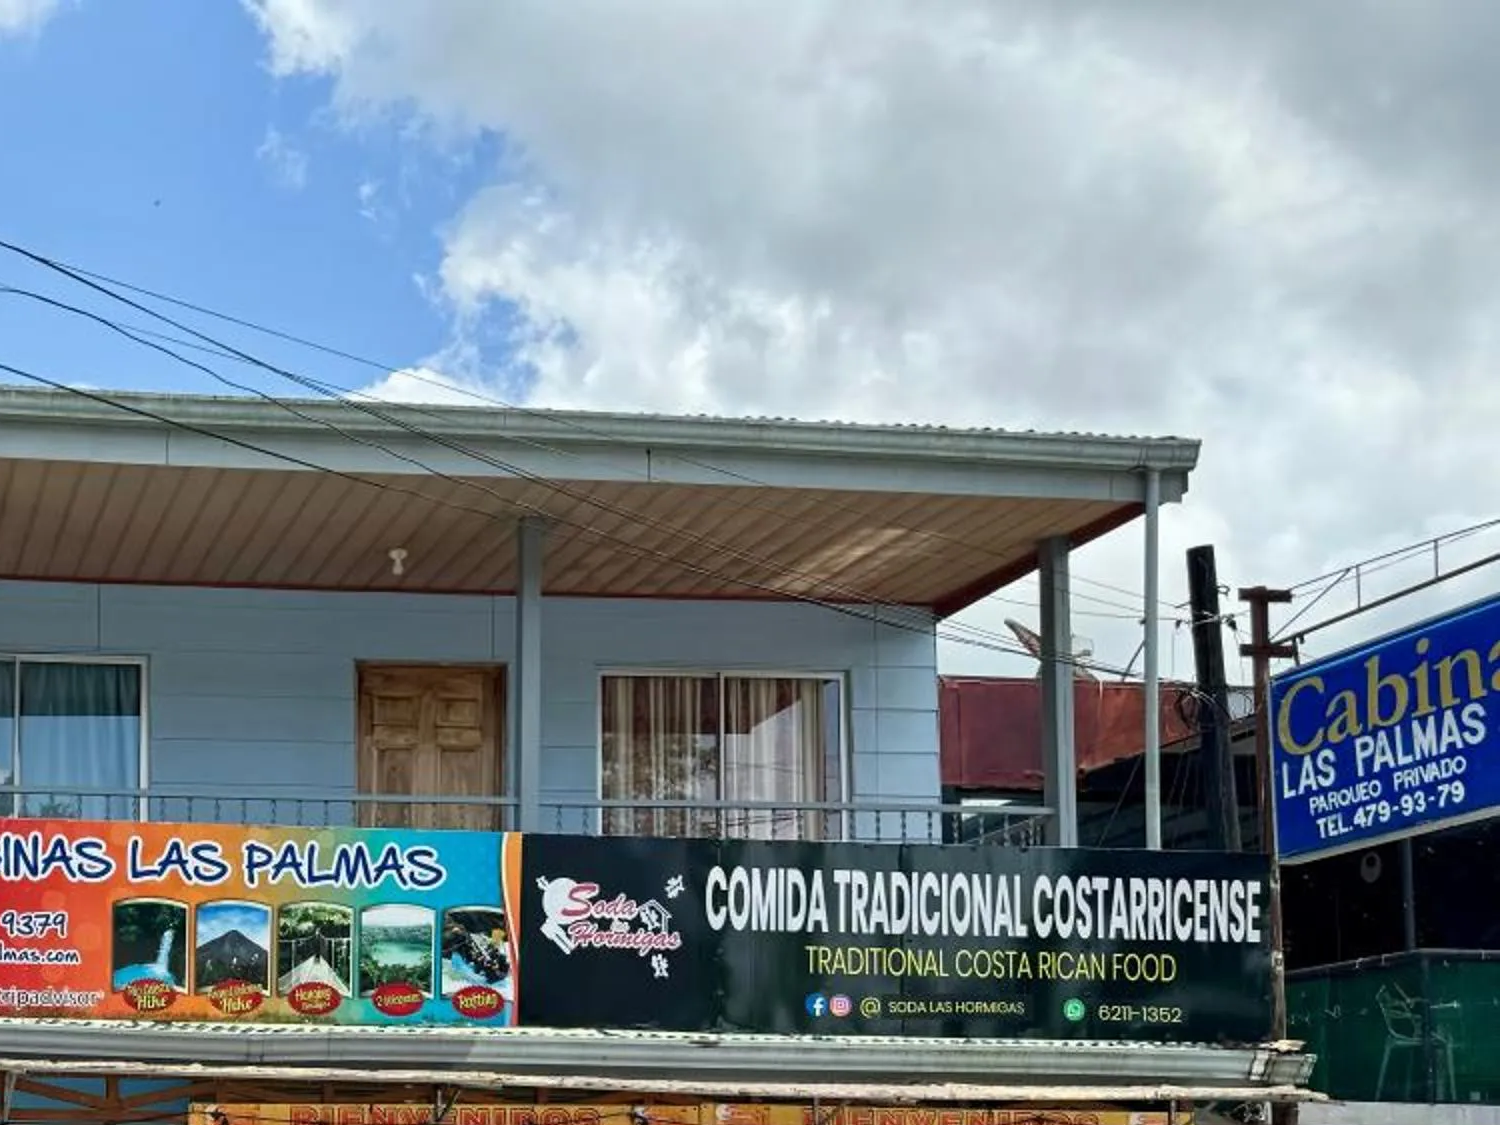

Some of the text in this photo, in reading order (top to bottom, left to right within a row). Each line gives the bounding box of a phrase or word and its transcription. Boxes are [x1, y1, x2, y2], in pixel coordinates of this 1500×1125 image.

[1281, 702, 1487, 799] LAS PALMAS
[1308, 755, 1467, 816] PARQUEO PRIVADO
[128, 835, 229, 883] LAS
[244, 839, 445, 891] PALMAS
[560, 882, 638, 919] Soda
[705, 866, 1261, 943] COMIDA TRADICIONAL COSTARRICENSE
[0, 911, 67, 939] 9379
[567, 920, 682, 956] Hormigas
[805, 945, 1176, 982] TRADITIONAL COSTA RICAN FOOD
[889, 1001, 925, 1013] SODA
[929, 1001, 953, 1014] LAS
[955, 1001, 1025, 1015] HORMIGAS
[1098, 1005, 1182, 1023] 6211-1352
